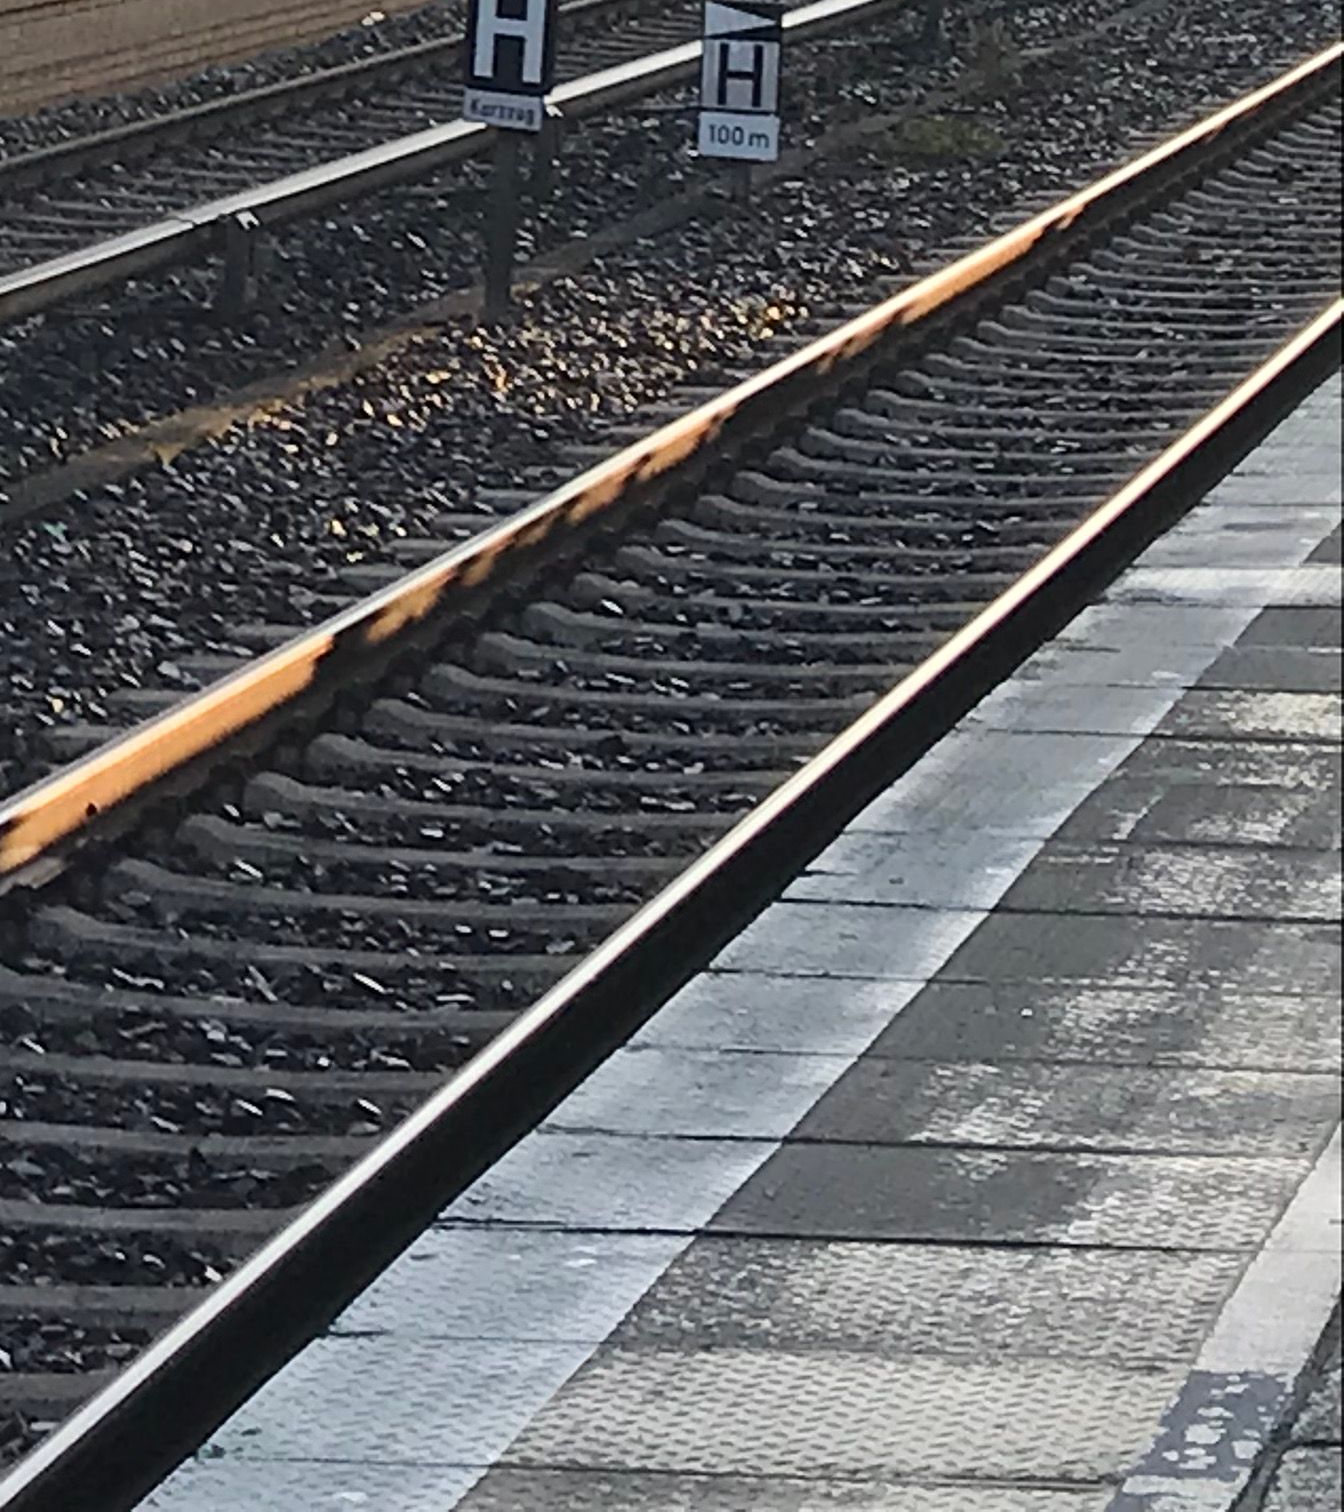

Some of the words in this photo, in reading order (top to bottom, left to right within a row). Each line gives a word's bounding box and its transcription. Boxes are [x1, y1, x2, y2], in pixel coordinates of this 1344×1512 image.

[717, 43, 764, 108] H
[709, 123, 744, 146] 100
[748, 132, 770, 149] m
